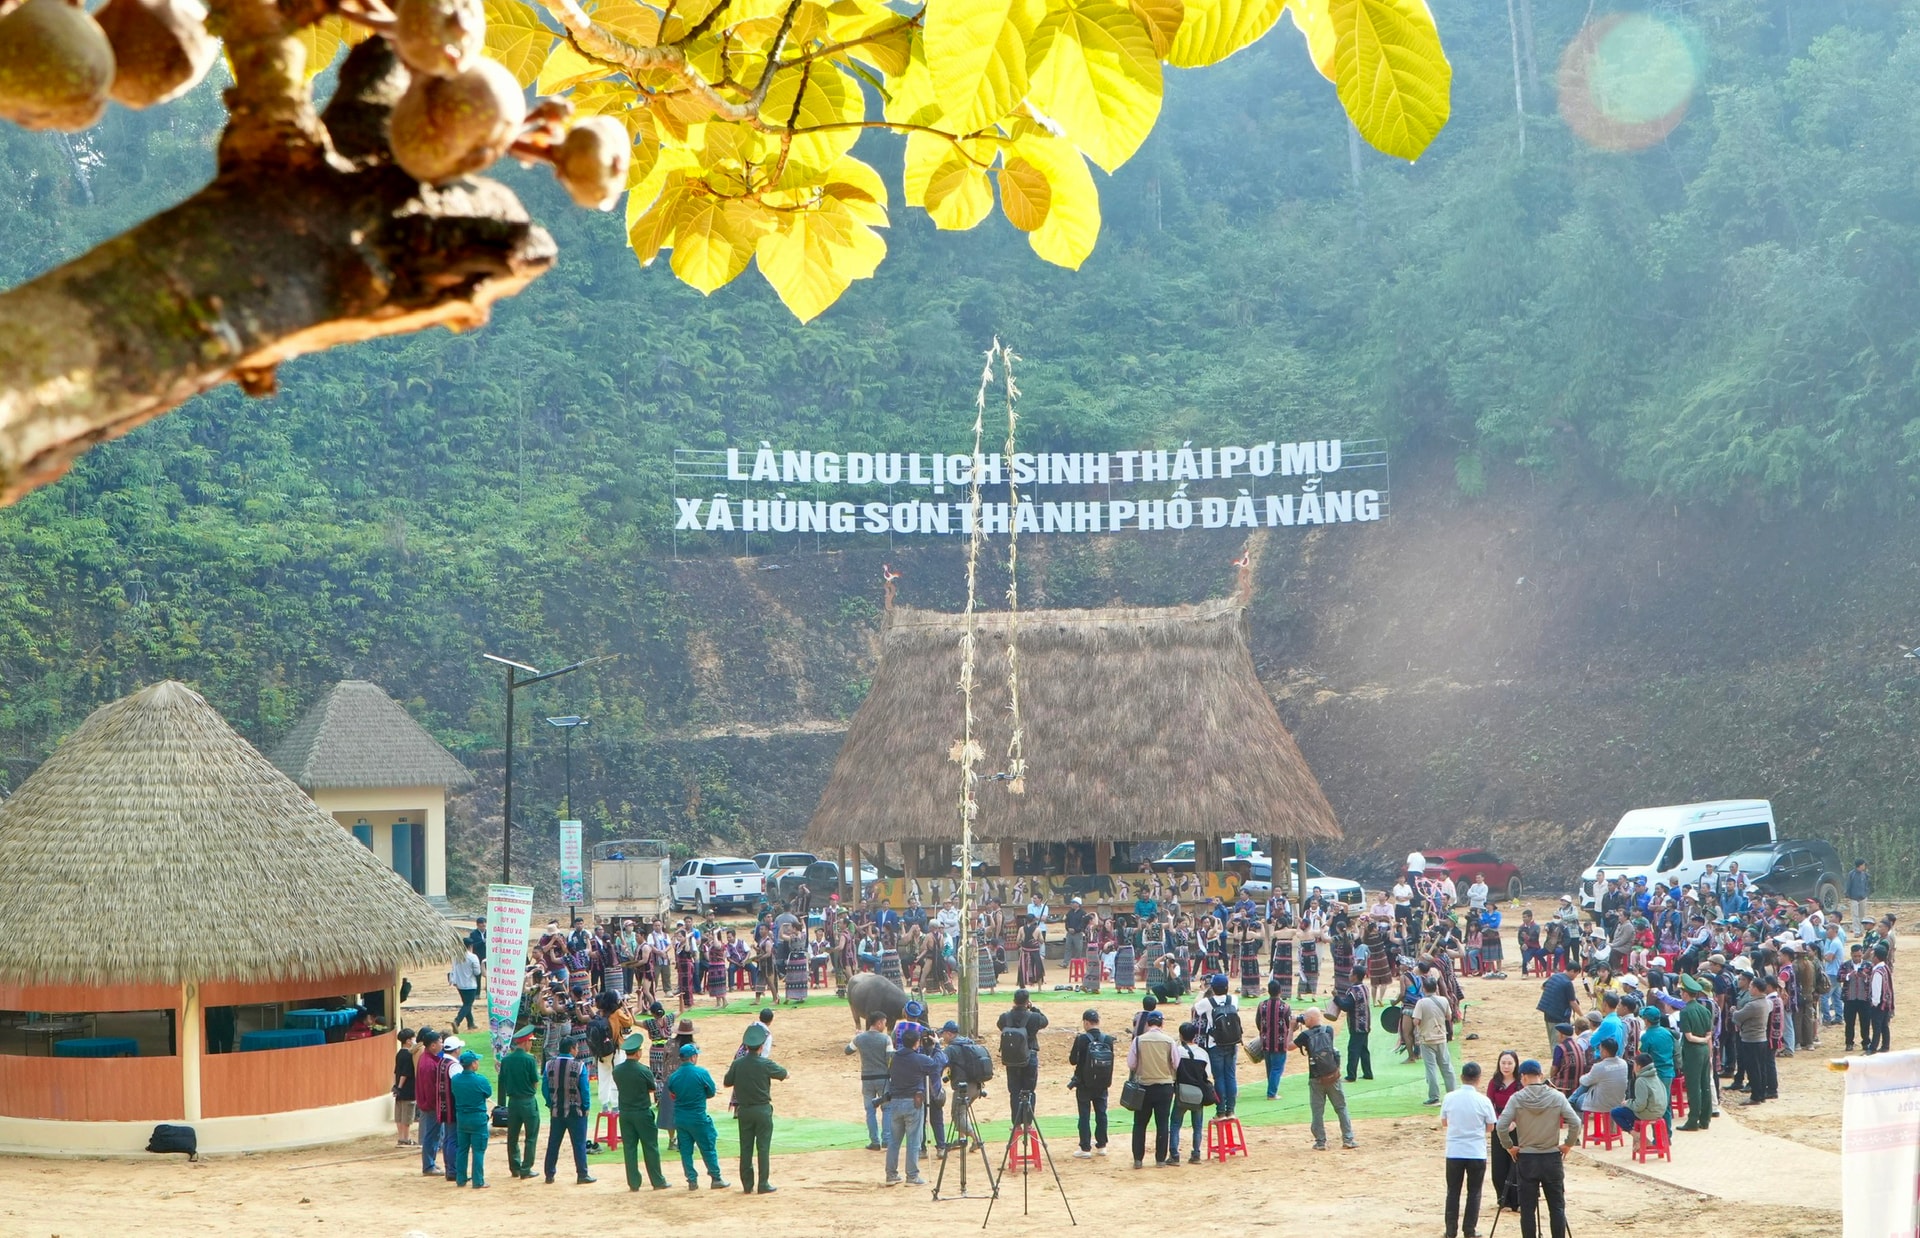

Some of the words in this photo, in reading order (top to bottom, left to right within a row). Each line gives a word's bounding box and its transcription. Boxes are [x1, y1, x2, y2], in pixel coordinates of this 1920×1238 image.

[727, 440, 840, 483] LÀNG
[847, 452, 902, 484] DU
[909, 452, 1001, 494] LỊCH
[1012, 452, 1110, 484] SINH
[1116, 440, 1214, 482] THÁI
[1220, 441, 1276, 478] PƠ
[1280, 439, 1342, 476] MU
[675, 493, 735, 531] XÃ
[742, 492, 856, 532] HÙNG
[956, 494, 1101, 533] THÀNH
[1109, 483, 1193, 532] PHỐ
[1201, 488, 1259, 529] ĐÀ
[1266, 477, 1380, 527] NẴNG
